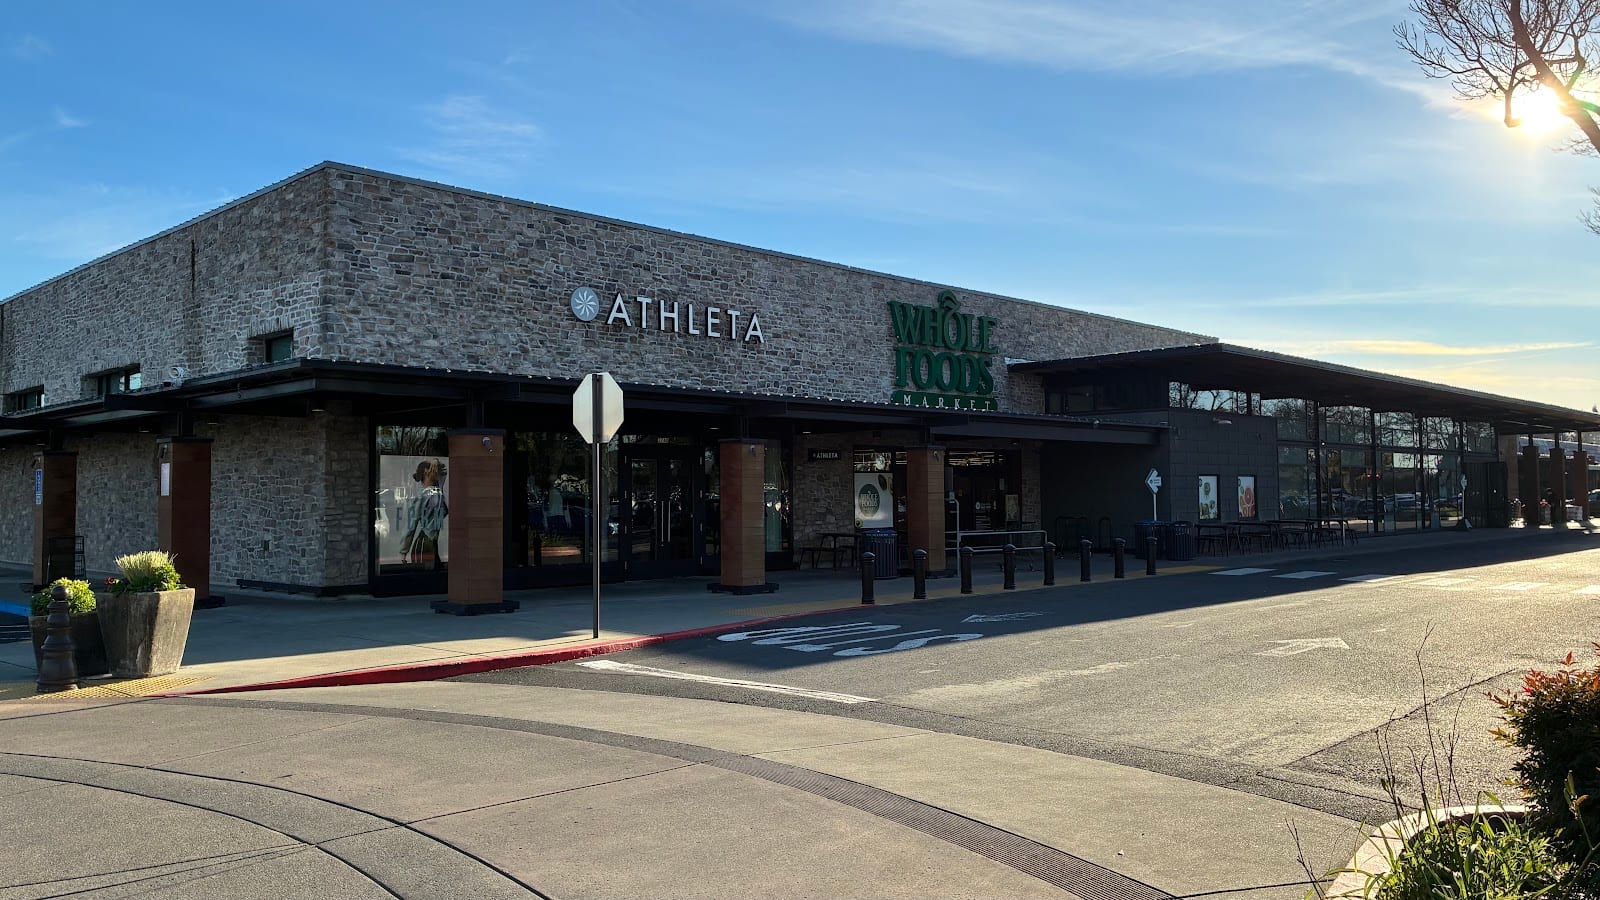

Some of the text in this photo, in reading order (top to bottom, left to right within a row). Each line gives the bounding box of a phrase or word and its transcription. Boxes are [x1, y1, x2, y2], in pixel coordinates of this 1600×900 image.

[606, 292, 765, 343] ATHLETA
[887, 291, 998, 353] WHOLE
[895, 346, 994, 395] FOODS
[903, 395, 990, 411] MARKET
[717, 622, 984, 656] STOP
